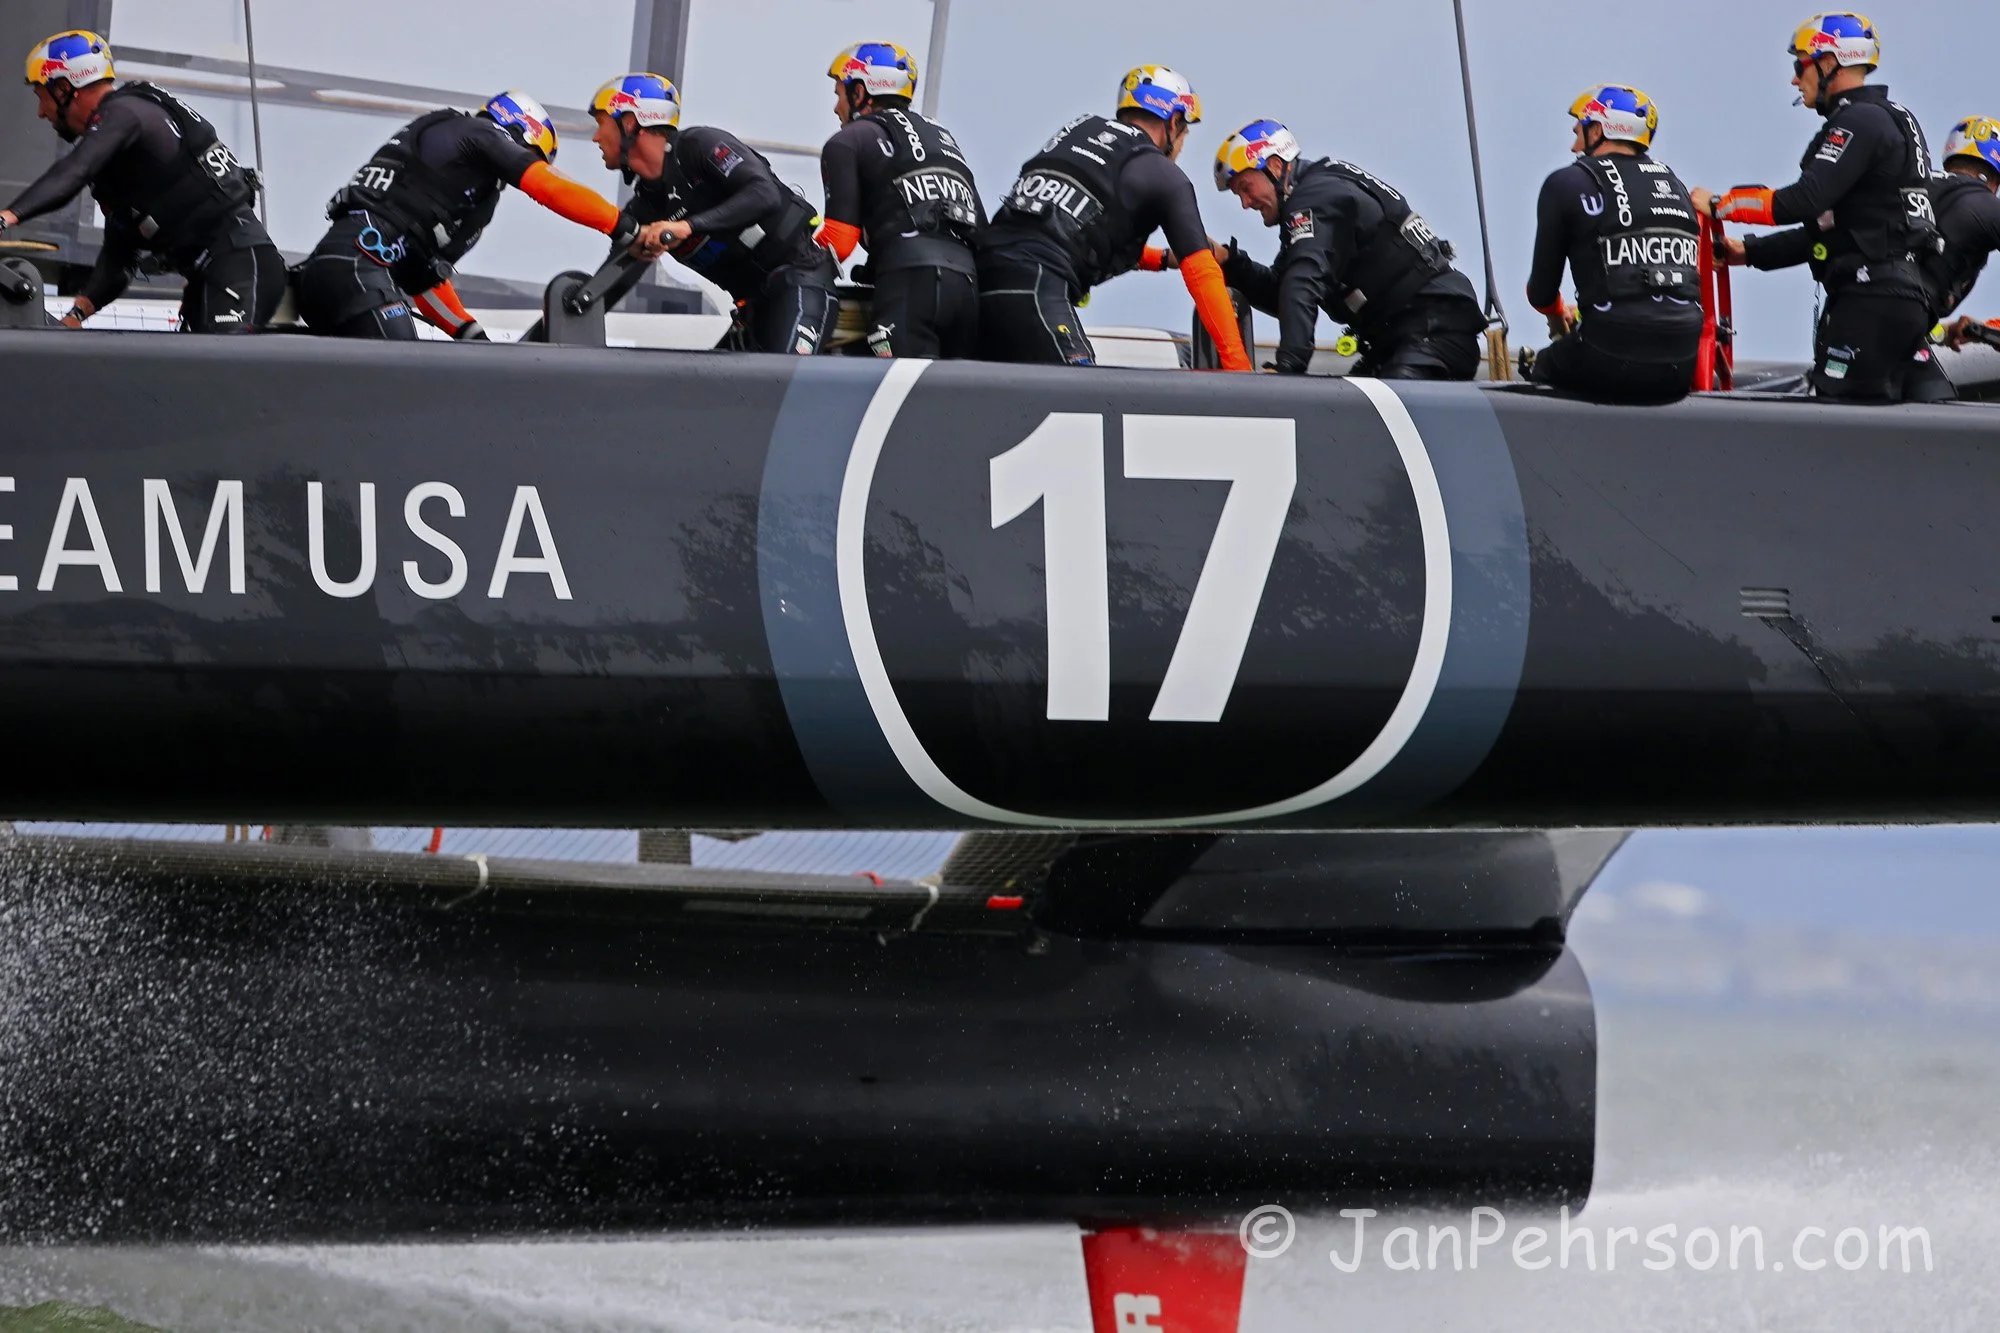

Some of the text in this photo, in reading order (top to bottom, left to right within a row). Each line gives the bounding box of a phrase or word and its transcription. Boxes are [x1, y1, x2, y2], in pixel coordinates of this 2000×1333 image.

[1965, 119, 1992, 141] 10
[1598, 159, 1633, 227] ORACLE
[1606, 237, 1698, 267] LANGFORD
[306, 481, 573, 600] USA
[990, 411, 1297, 722] 17
